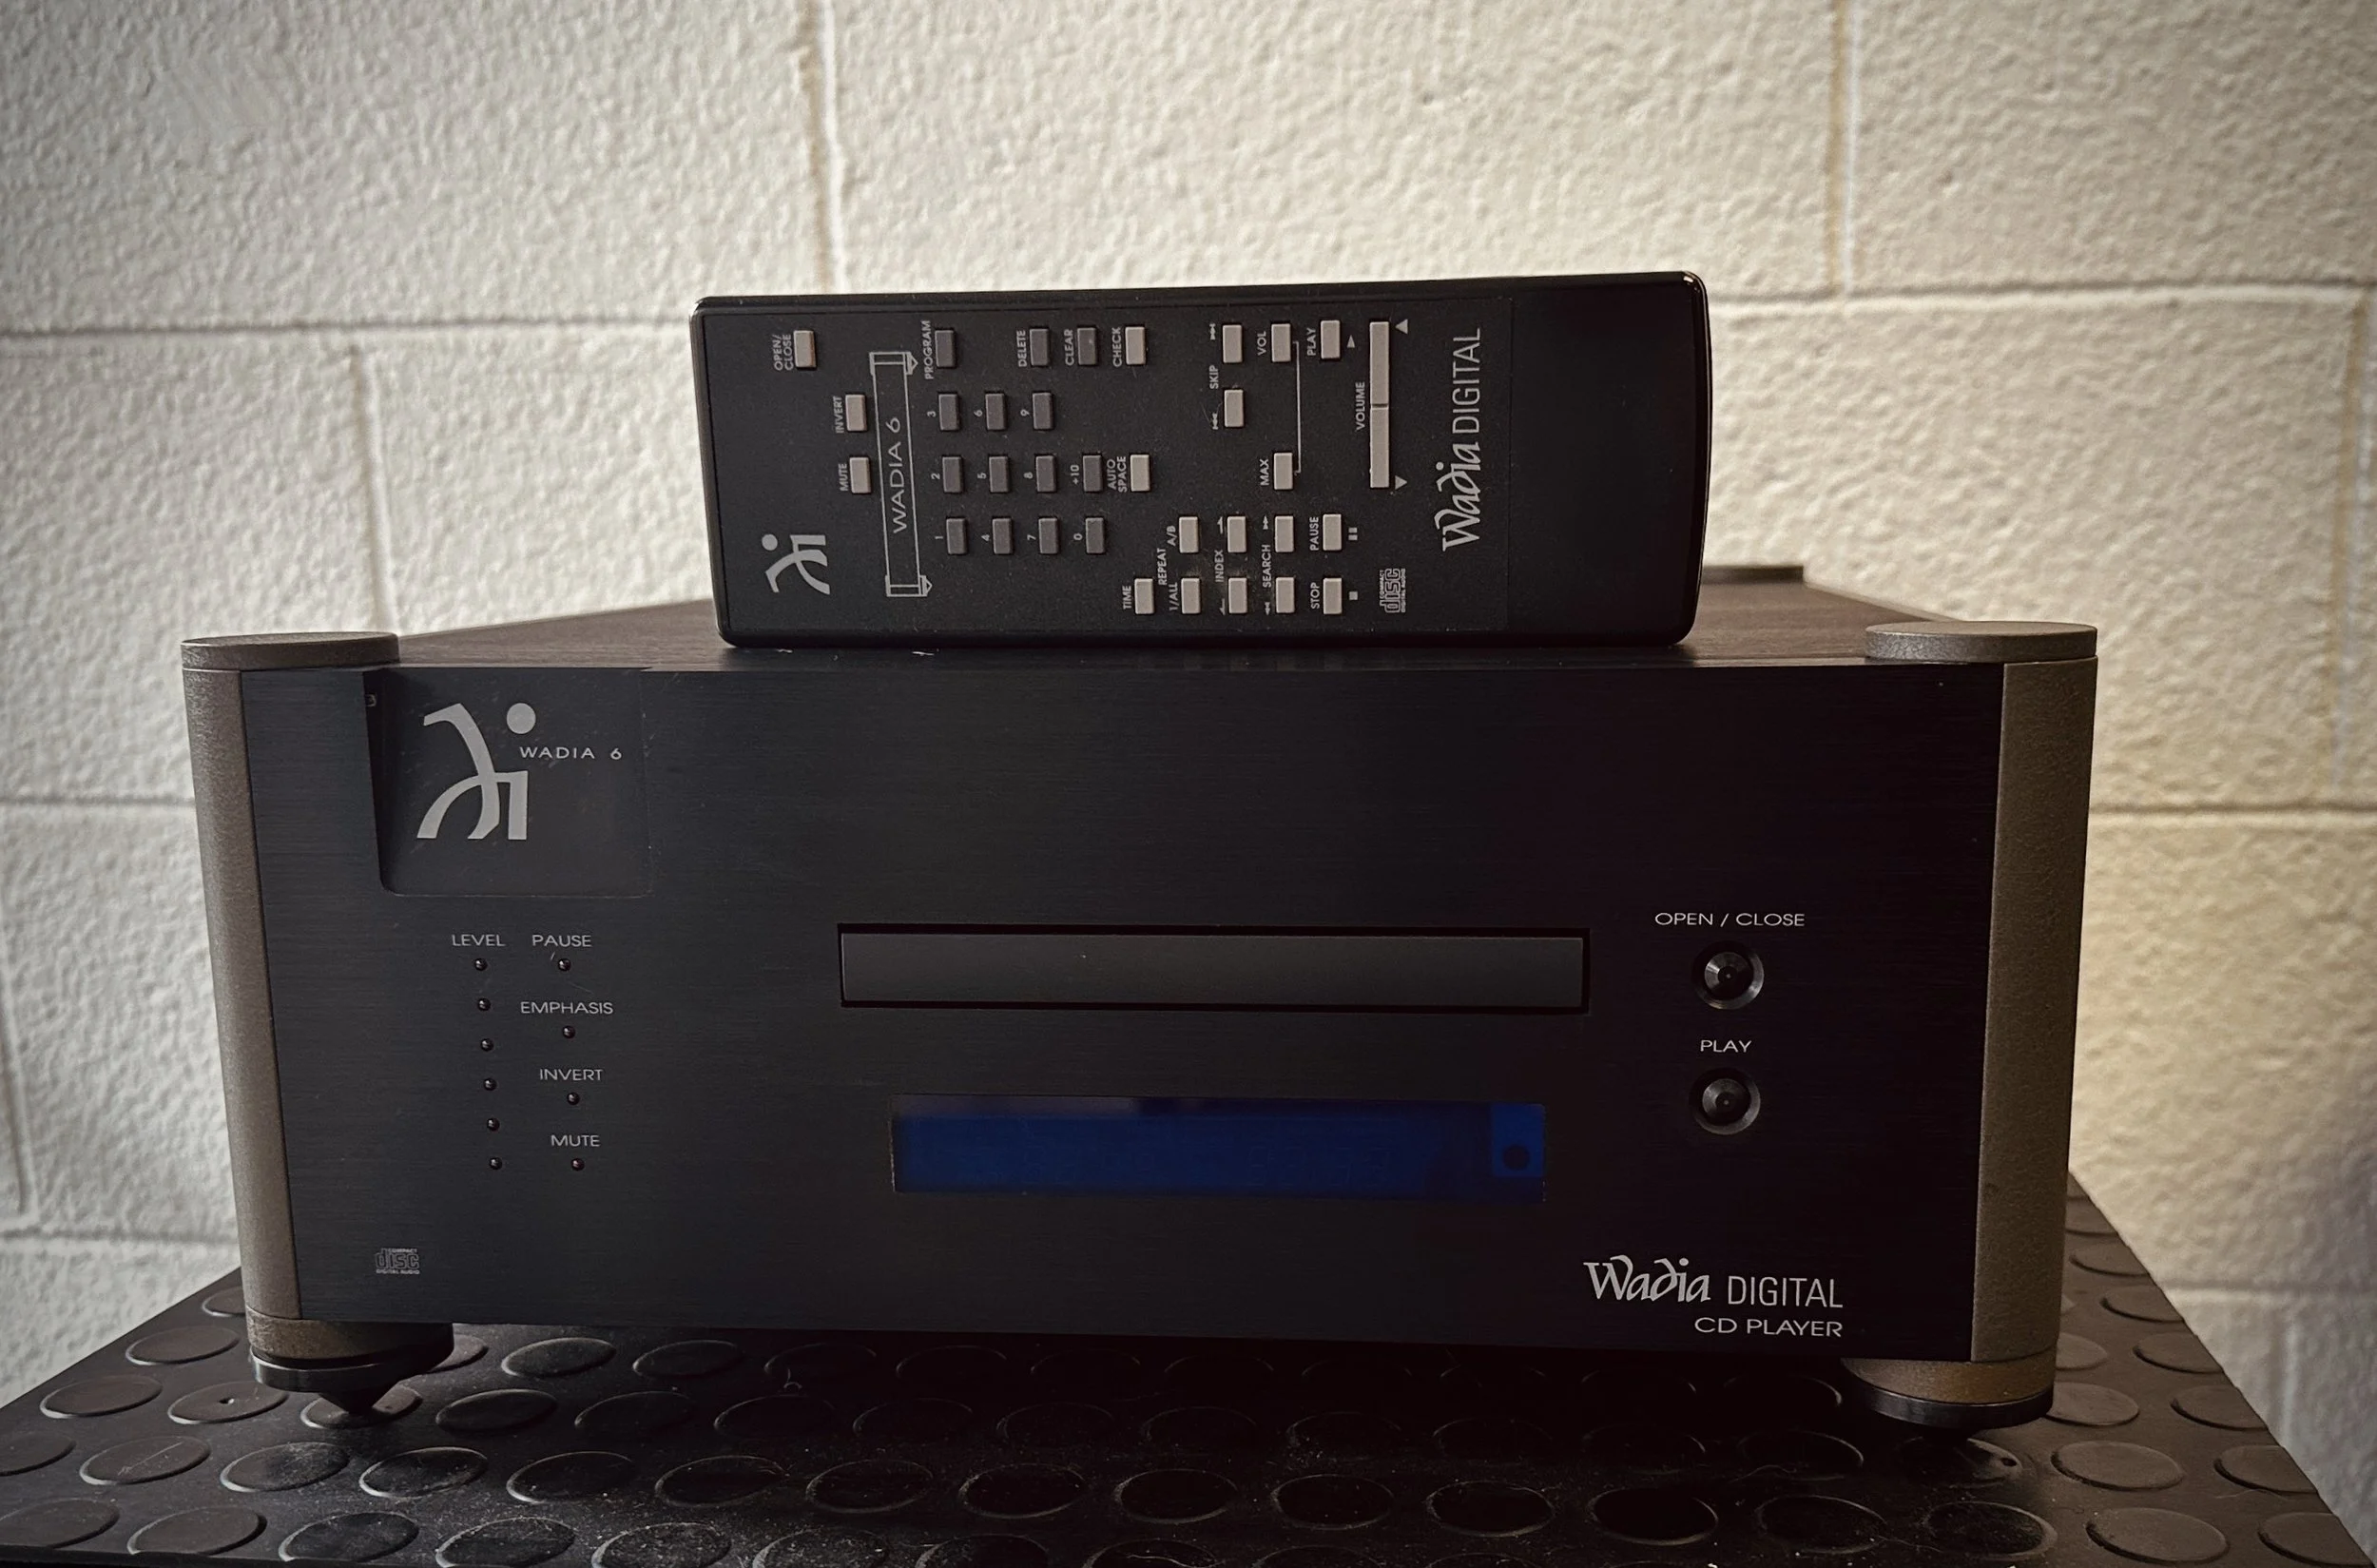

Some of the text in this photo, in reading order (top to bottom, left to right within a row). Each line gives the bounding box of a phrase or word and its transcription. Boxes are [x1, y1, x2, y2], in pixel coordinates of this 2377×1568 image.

[774, 334, 783, 371] OPEN/
[783, 334, 794, 371] CLOSE
[920, 319, 934, 379] PROGRAM
[1016, 330, 1027, 367] DELETE
[1064, 329, 1074, 366] CLEAR
[1111, 327, 1122, 367] CHECK
[1257, 331, 1267, 356] VOL
[1306, 327, 1317, 357] PLAY
[1208, 365, 1219, 389] SKIP
[833, 396, 844, 434] INVERT
[1355, 381, 1365, 431] VOLUME
[1434, 328, 1481, 552] Wadia DIGITAL
[839, 462, 848, 492] MUTE
[886, 416, 908, 534] WADIA 6
[1106, 458, 1117, 490] AUTO
[1116, 455, 1129, 494] SPACE
[1260, 458, 1269, 486] MAX
[1167, 525, 1177, 547] A/B
[1309, 516, 1320, 552] PAUSE
[1157, 548, 1168, 586] REPEAT
[1214, 550, 1225, 583] INDEX
[1262, 544, 1272, 588] SEARCH
[1122, 585, 1131, 610] TIME
[1310, 582, 1321, 610] STOP
[519, 746, 622, 761] WADIA 6
[1654, 913, 1713, 925] OPEN
[1736, 913, 1806, 926] CLOSE
[452, 934, 506, 947] LEVEL
[531, 934, 592, 948] PAUSE
[520, 1001, 614, 1015] EMPHASIS
[1700, 1039, 1751, 1054] PLAY
[539, 1068, 603, 1081] INVERT
[551, 1134, 600, 1147] MUTE
[1583, 1254, 1844, 1307] Wadia DIGITAL
[1694, 1317, 1843, 1337] CD PLAYER
